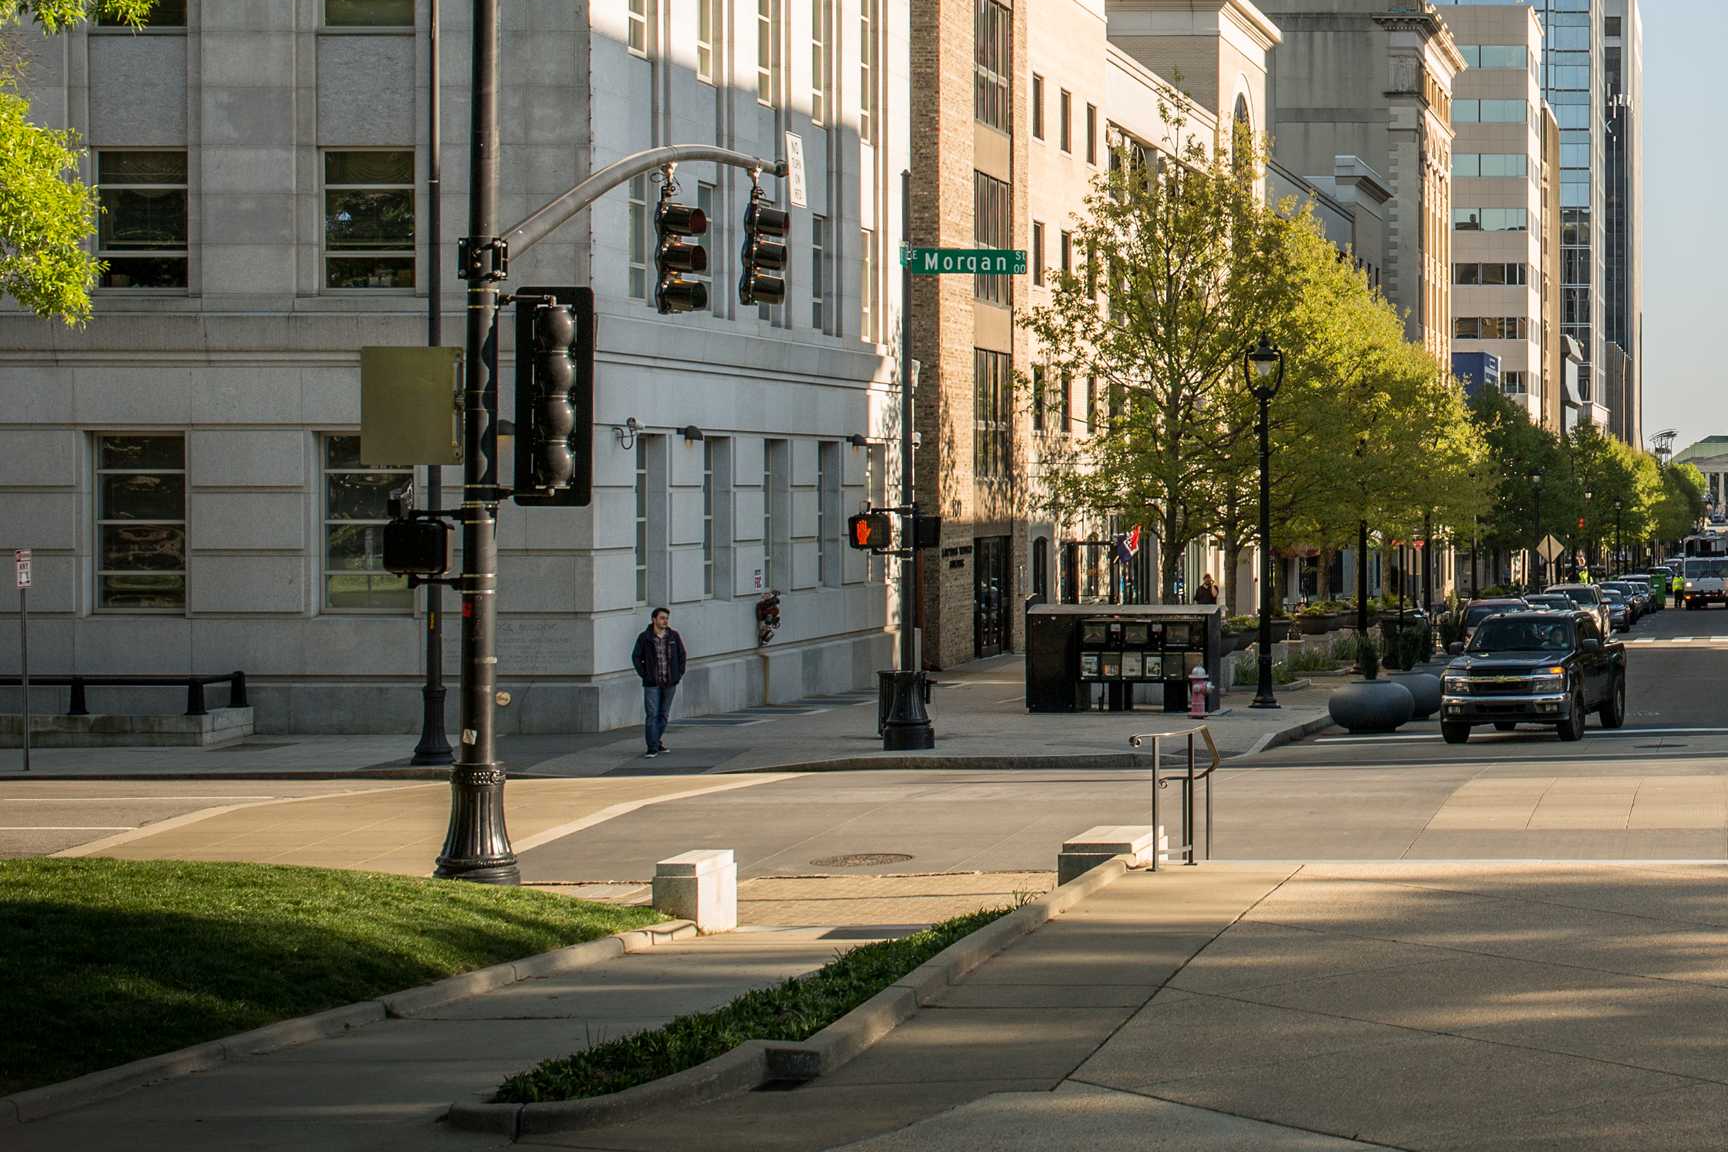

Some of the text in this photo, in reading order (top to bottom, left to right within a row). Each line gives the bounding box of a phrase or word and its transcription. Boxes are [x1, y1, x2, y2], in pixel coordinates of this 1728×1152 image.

[924, 252, 1007, 273] Morgan
[1015, 251, 1026, 261] St
[1013, 264, 1026, 274] 00
